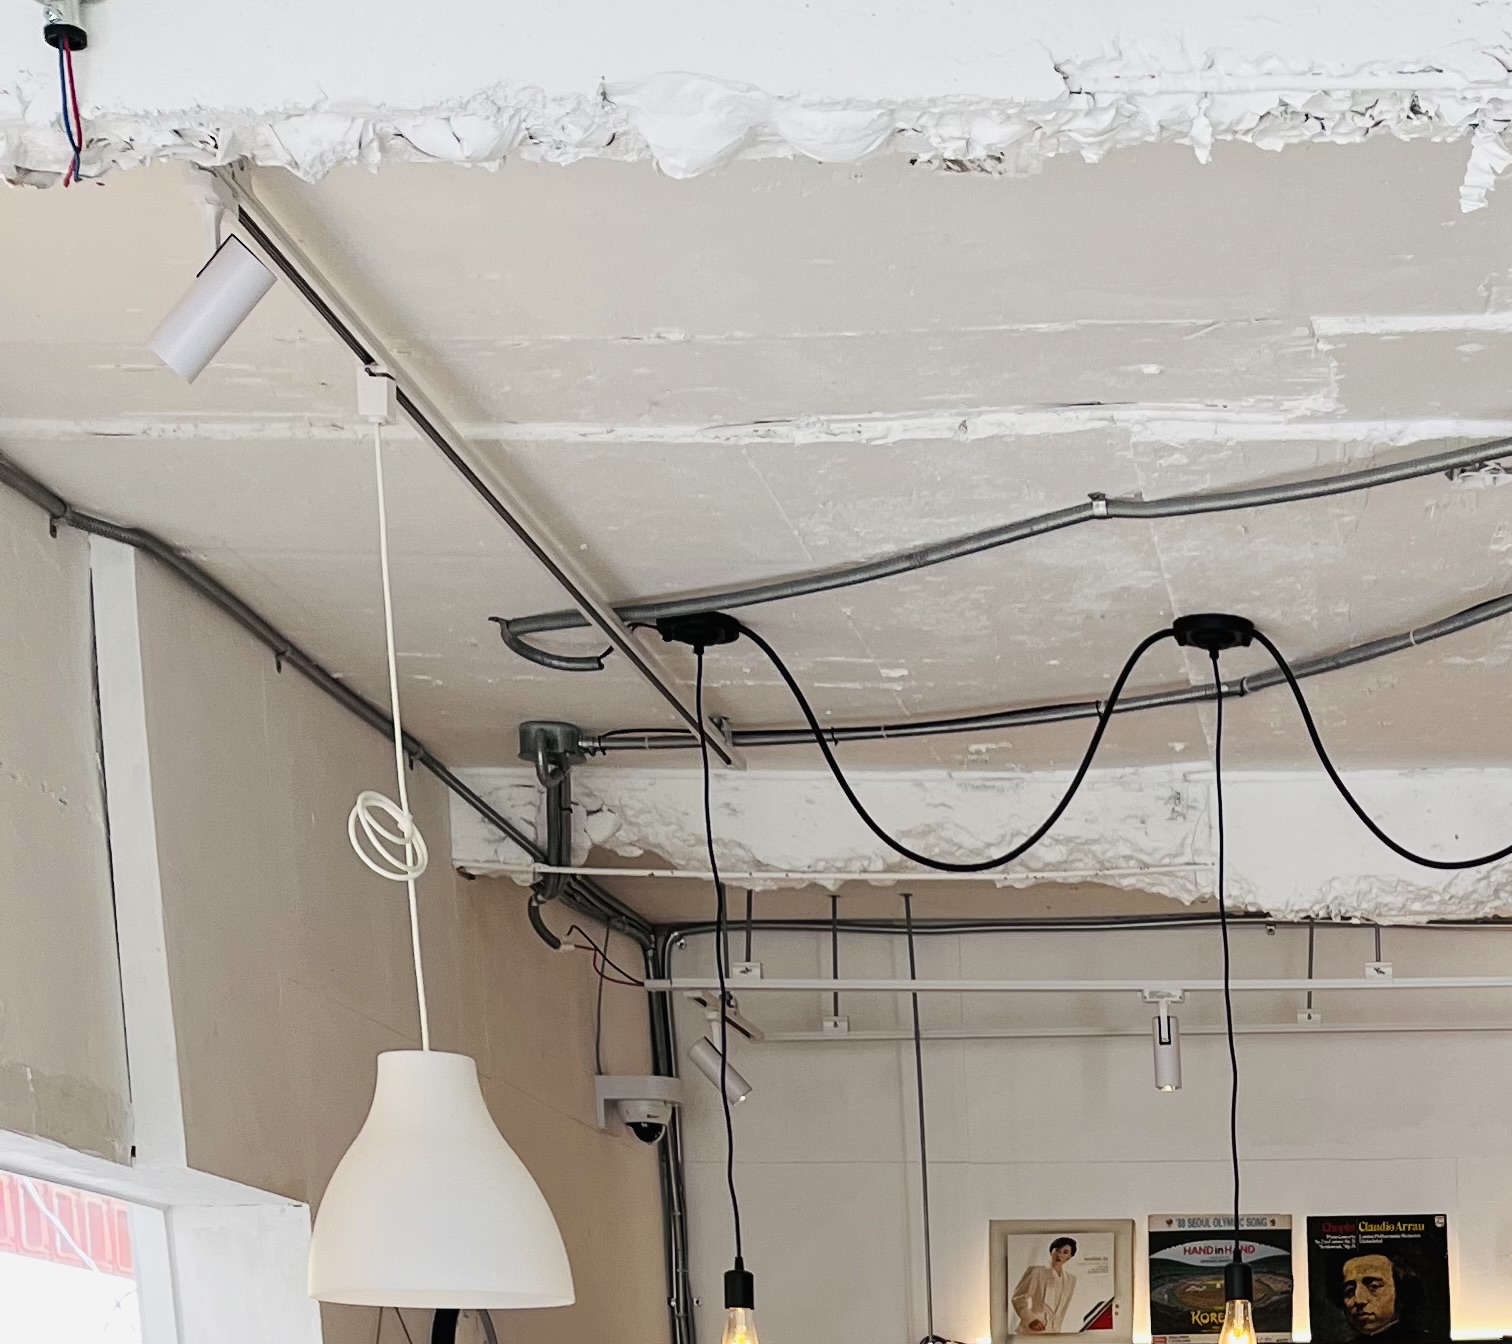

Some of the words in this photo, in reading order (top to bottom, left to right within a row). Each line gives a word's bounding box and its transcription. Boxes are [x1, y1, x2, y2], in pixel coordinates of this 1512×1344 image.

[1188, 1217, 1211, 1228] SEOUL
[1247, 1216, 1268, 1226] SONG
[1358, 1221, 1394, 1232] Claudio
[1396, 1222, 1424, 1231] Arrau
[1183, 1246, 1214, 1255] HAND
[1215, 1245, 1223, 1254] in
[1225, 1245, 1255, 1254] HND
[1191, 1310, 1226, 1326] KORE
